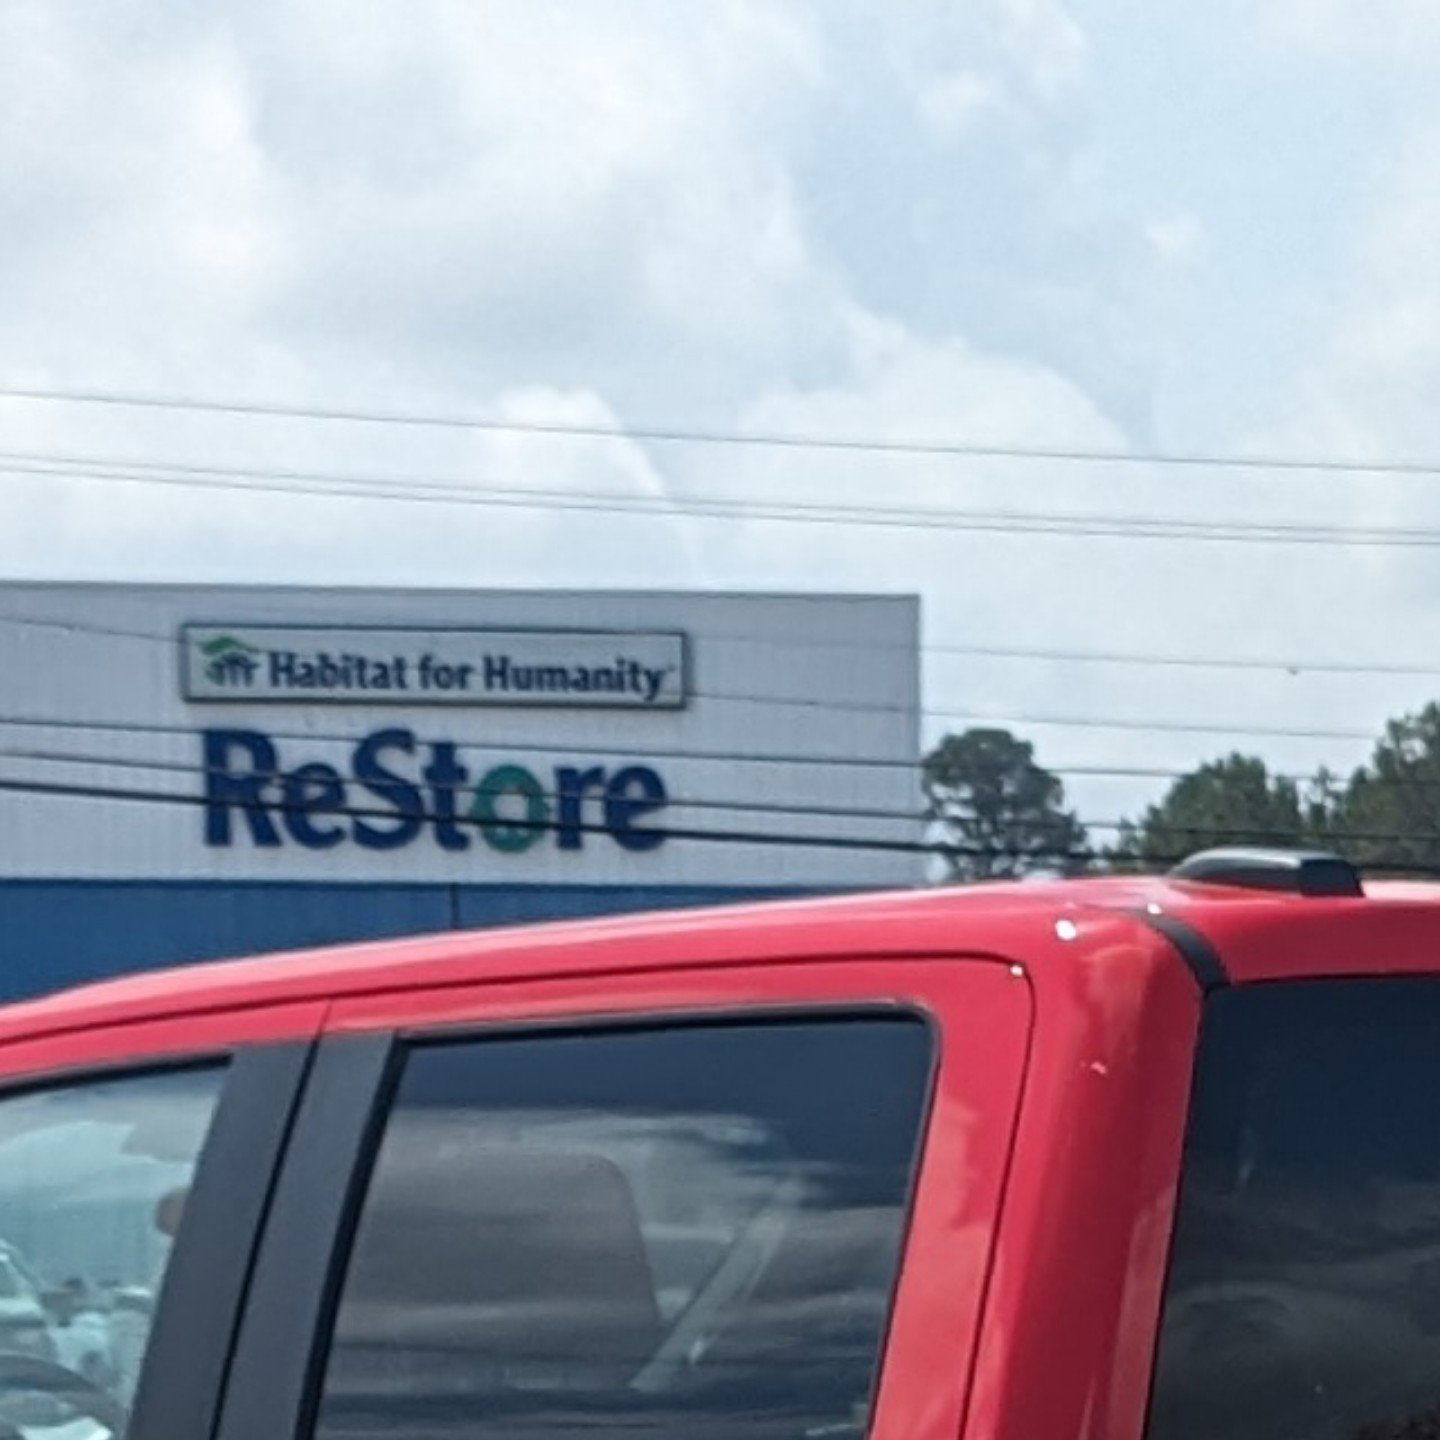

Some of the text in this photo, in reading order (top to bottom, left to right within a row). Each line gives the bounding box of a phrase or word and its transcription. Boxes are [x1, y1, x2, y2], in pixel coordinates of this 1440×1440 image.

[268, 651, 664, 701] Habitat for Humanity
[201, 727, 667, 854] ReStore
